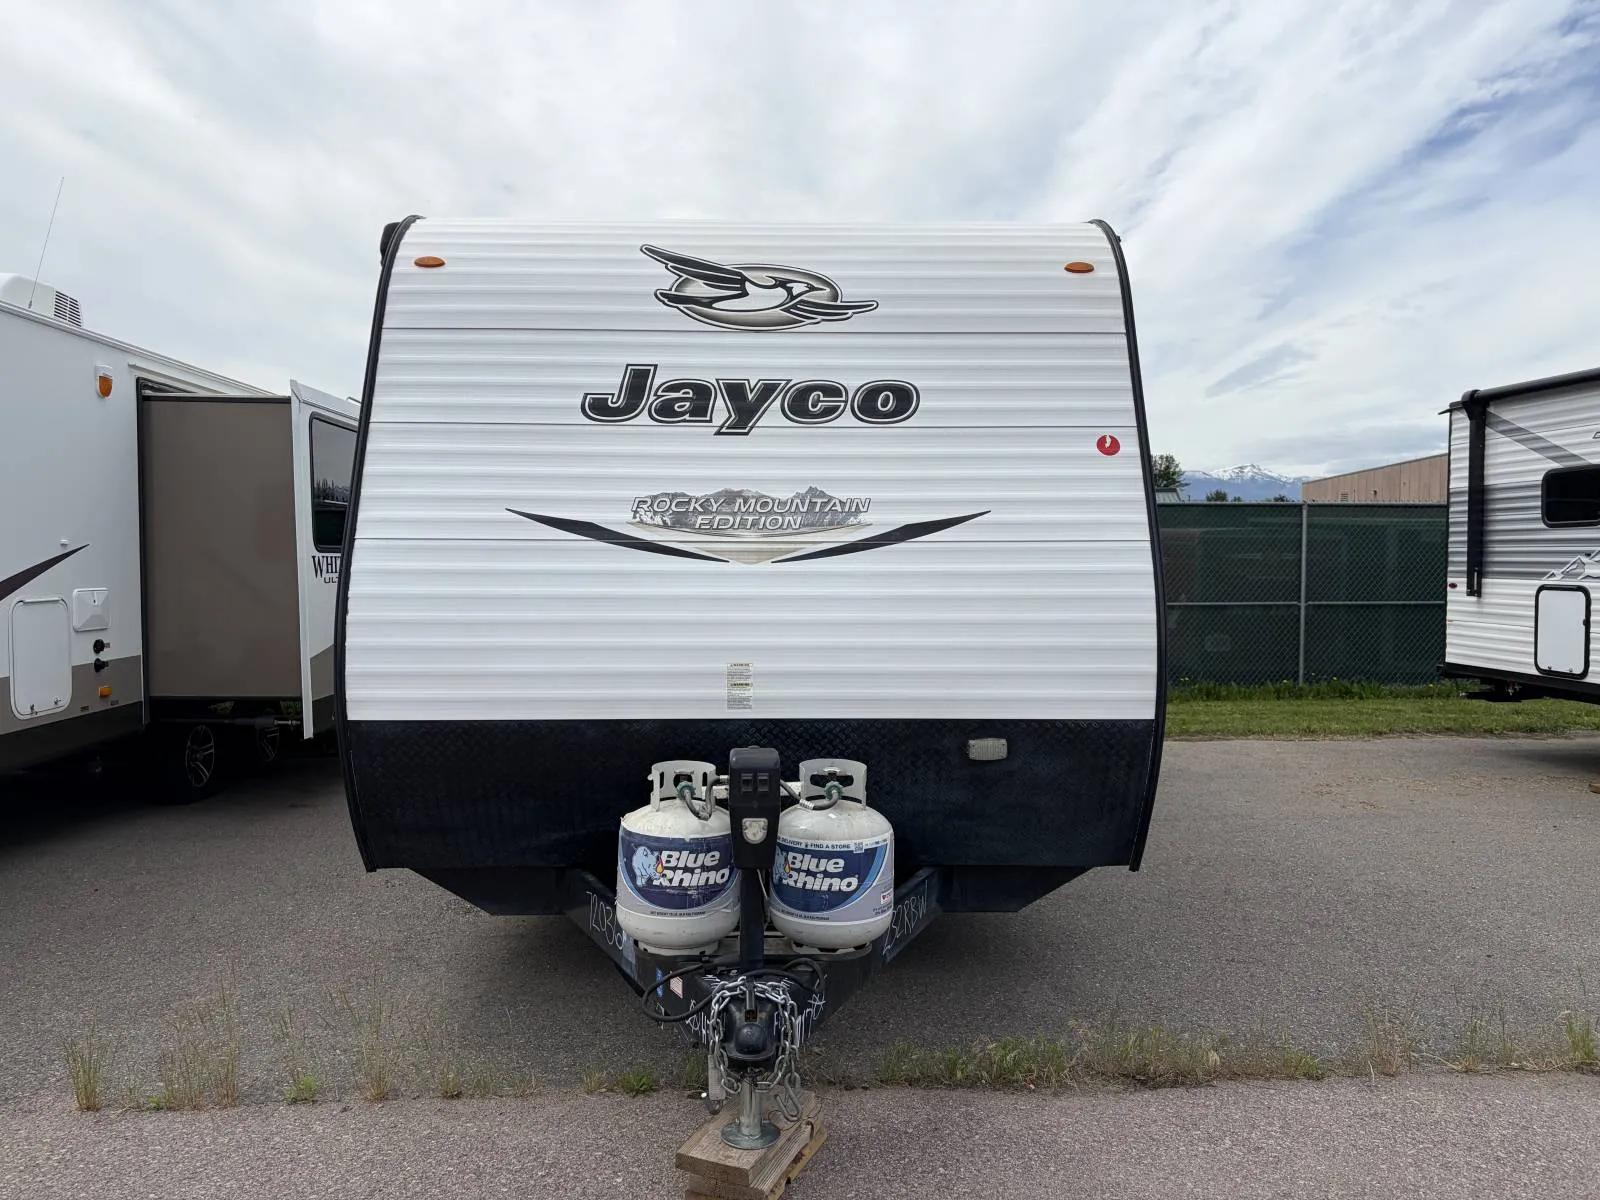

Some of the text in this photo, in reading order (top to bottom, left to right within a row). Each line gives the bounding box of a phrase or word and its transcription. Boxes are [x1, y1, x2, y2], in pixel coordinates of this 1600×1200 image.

[581, 364, 920, 435] Jayco
[631, 496, 872, 513] ROCKY MOUNTAIN
[695, 515, 802, 530] EDITION
[311, 555, 341, 579] WHI
[661, 850, 720, 868] Blue
[787, 852, 845, 872] Blue
[652, 868, 730, 887] Rhino
[782, 870, 858, 892] Rhino
